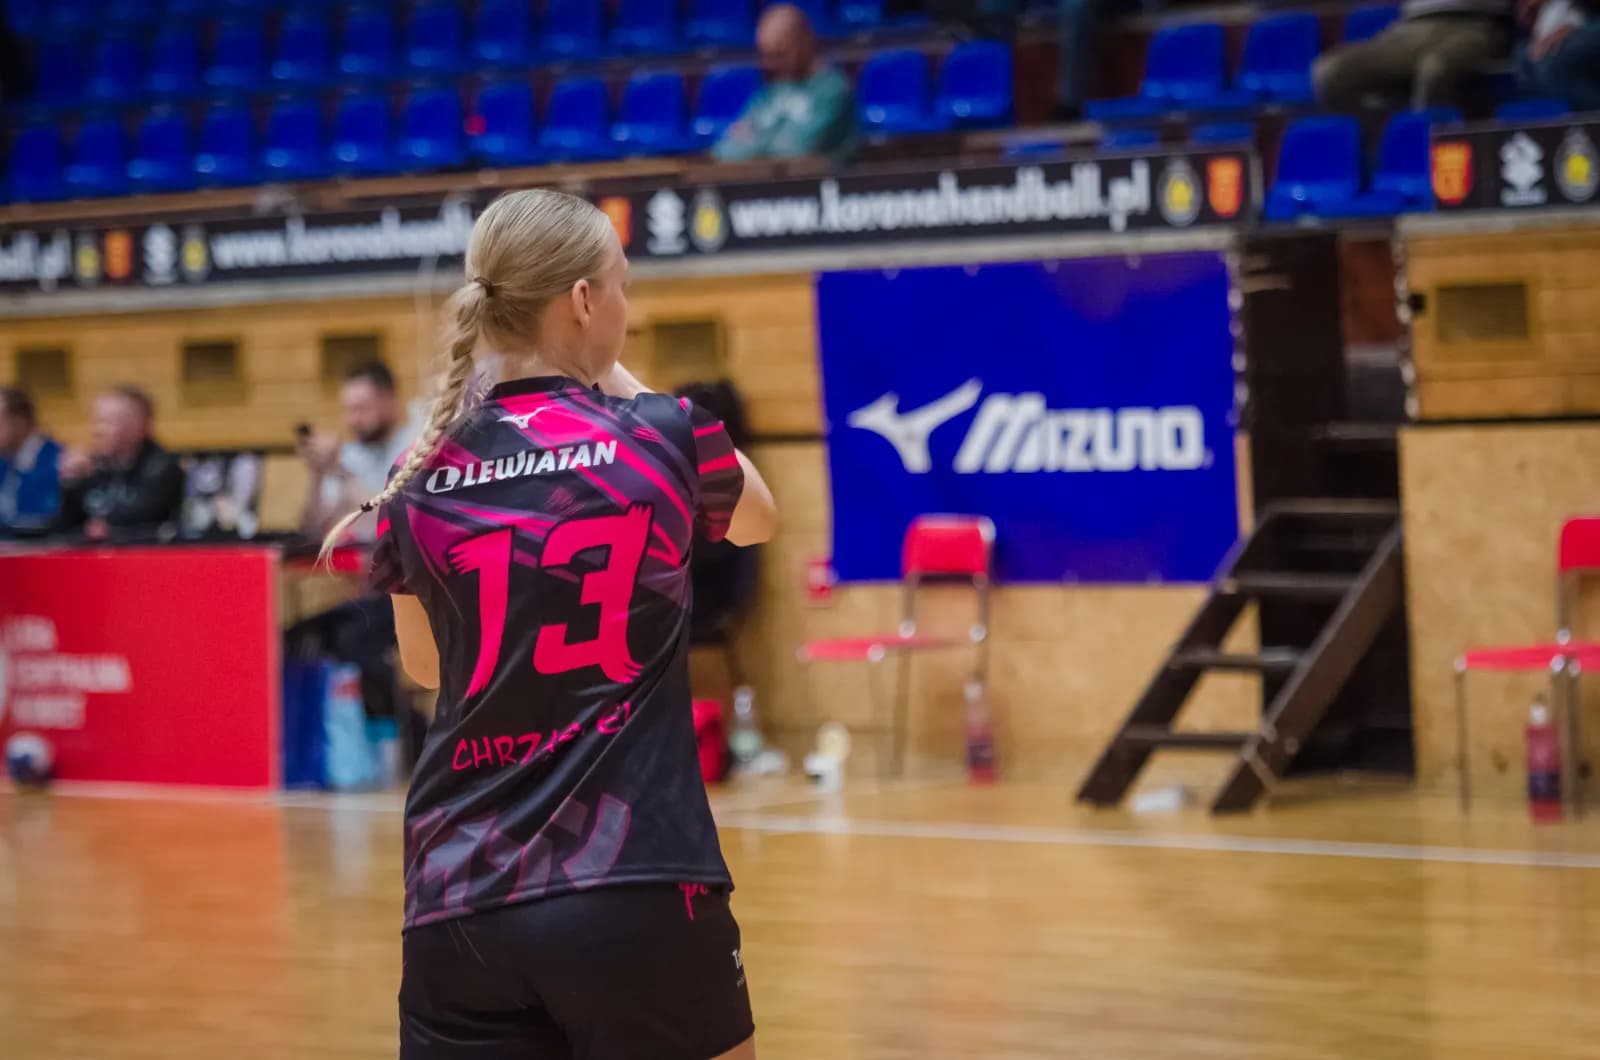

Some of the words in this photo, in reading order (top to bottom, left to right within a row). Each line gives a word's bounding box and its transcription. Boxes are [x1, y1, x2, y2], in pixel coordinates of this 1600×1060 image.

[730, 158, 1151, 233] www.koronahandball.pl
[462, 440, 617, 487] LEWIATAN
[953, 391, 1205, 474] MIZUNO
[447, 502, 655, 697] 13
